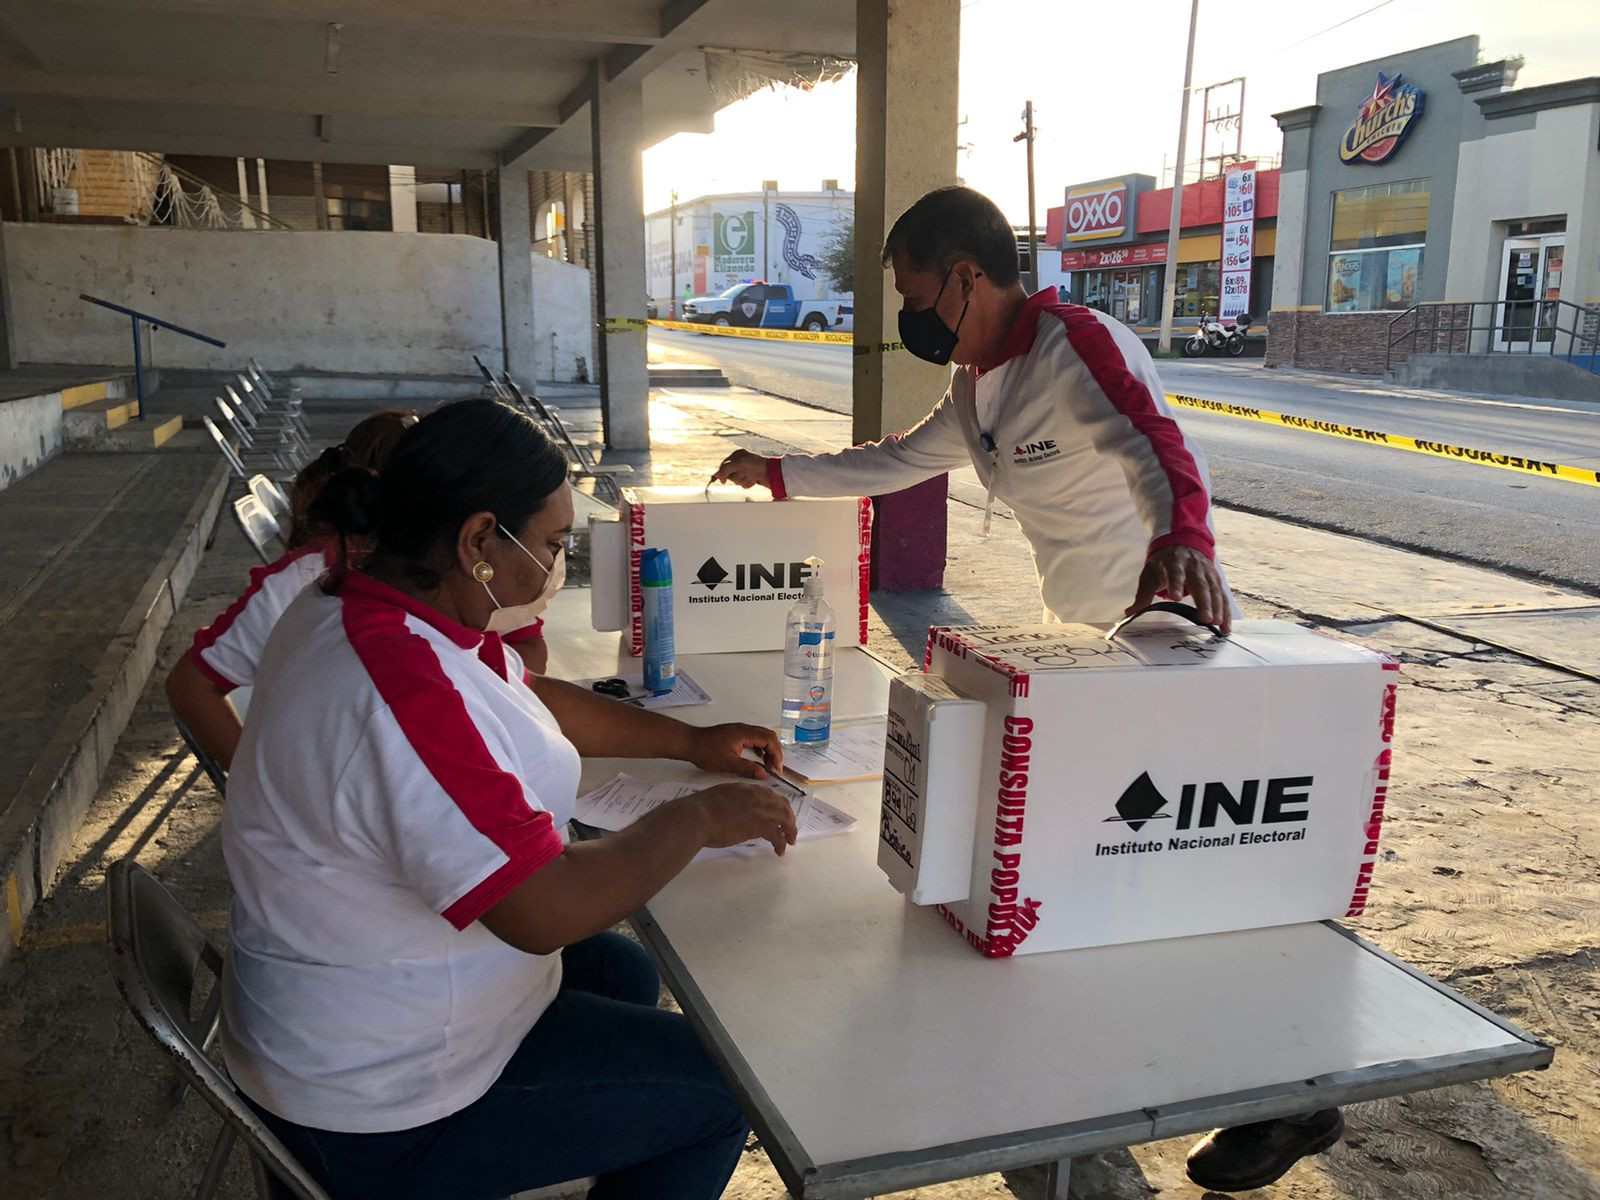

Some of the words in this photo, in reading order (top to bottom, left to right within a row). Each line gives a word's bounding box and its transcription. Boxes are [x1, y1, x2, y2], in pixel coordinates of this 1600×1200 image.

[1340, 91, 1416, 160] Church's
[1069, 191, 1121, 233] OXXO
[713, 264, 755, 273] Elizondo
[1026, 439, 1057, 455] INE
[736, 562, 813, 591] INE
[689, 594, 730, 604] Instituto
[732, 593, 775, 603] Nacional
[994, 714, 1035, 848] CONSULTA
[1175, 775, 1315, 831] INE
[1095, 842, 1163, 857] Instituto
[1167, 834, 1236, 851] Nacional
[1238, 827, 1307, 846] Electoral
